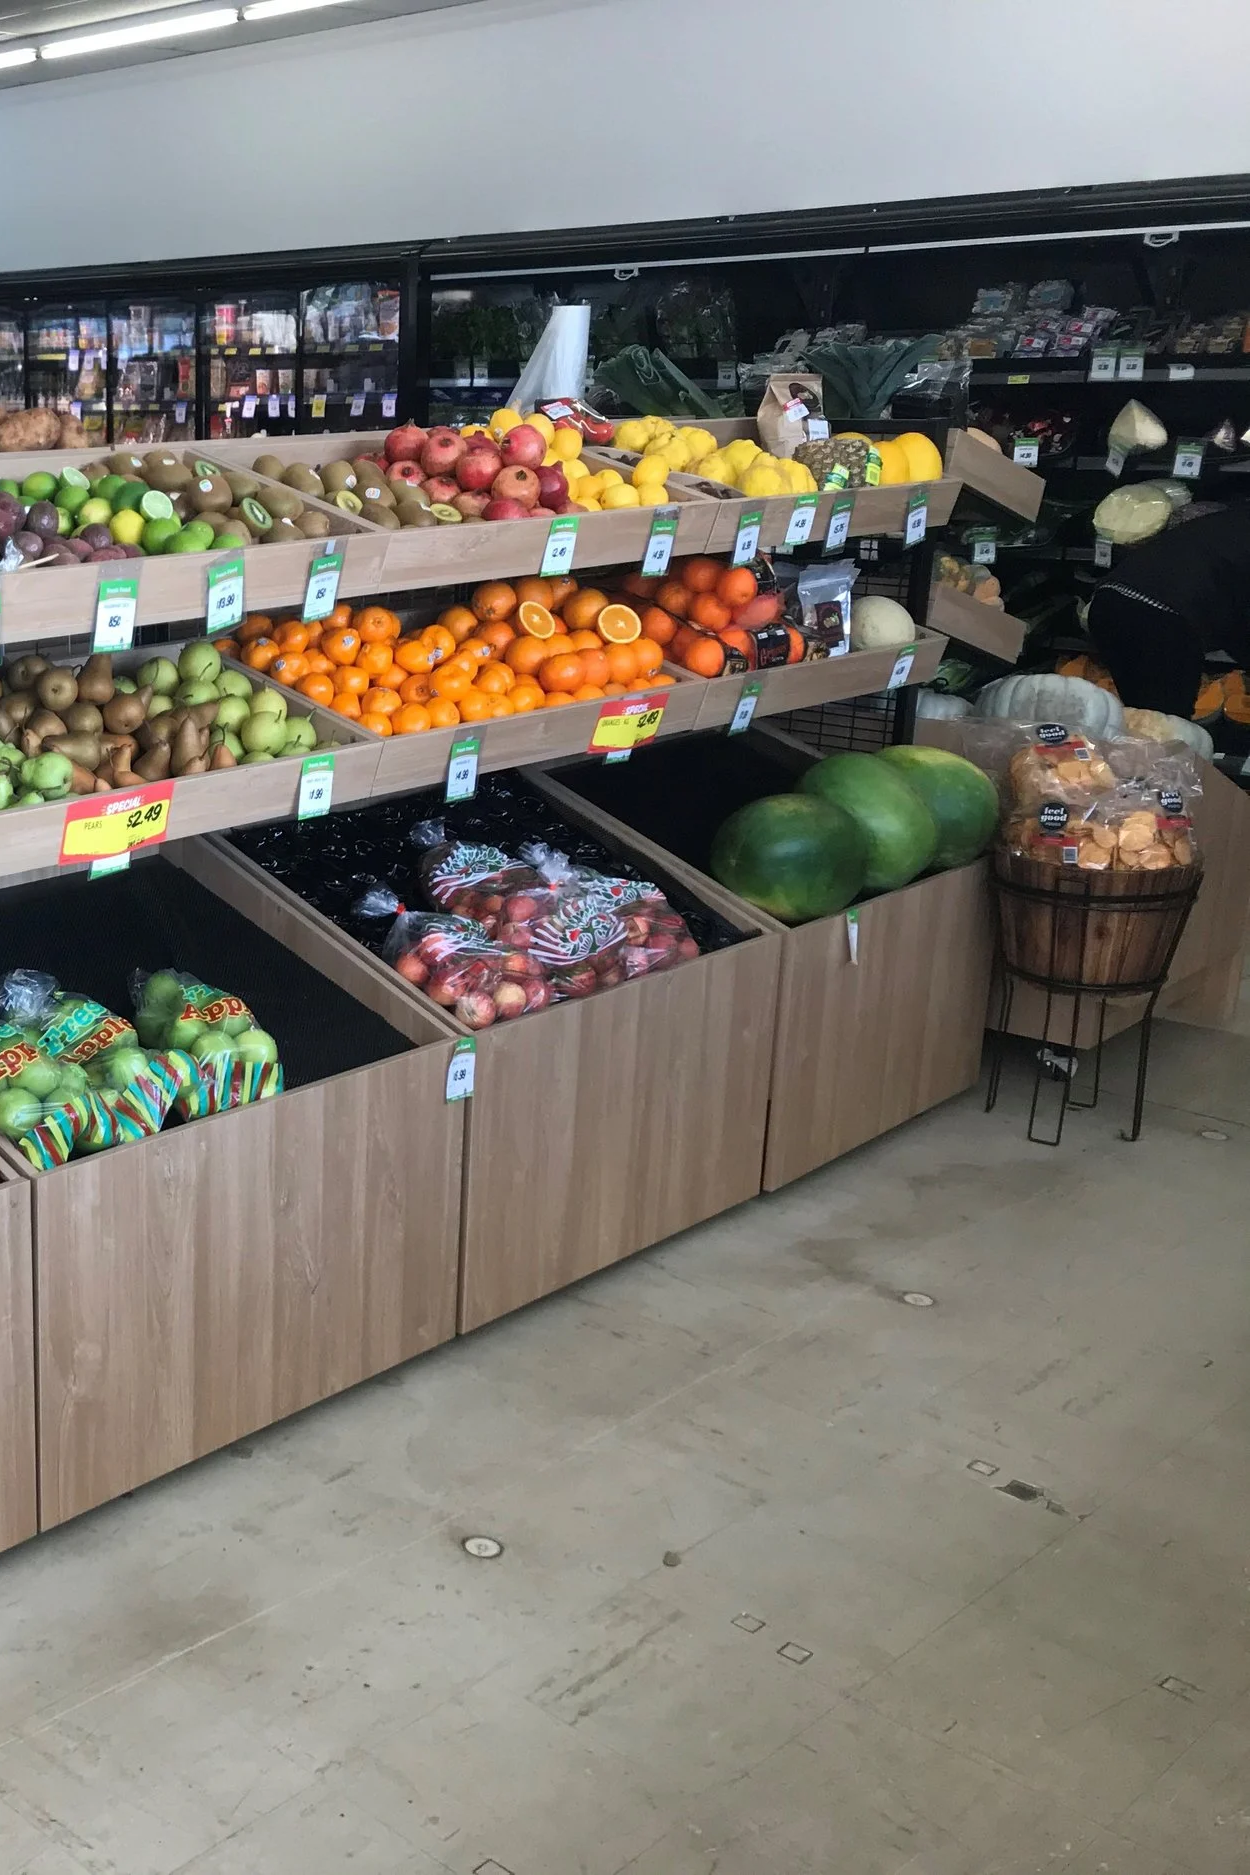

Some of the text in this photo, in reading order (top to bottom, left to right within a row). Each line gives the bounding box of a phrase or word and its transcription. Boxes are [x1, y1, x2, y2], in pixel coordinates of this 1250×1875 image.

[83, 803, 163, 830] PEARS $2.49
[105, 795, 142, 815] SPECIAL
[1040, 814, 1068, 823] good
[179, 996, 254, 1024] App
